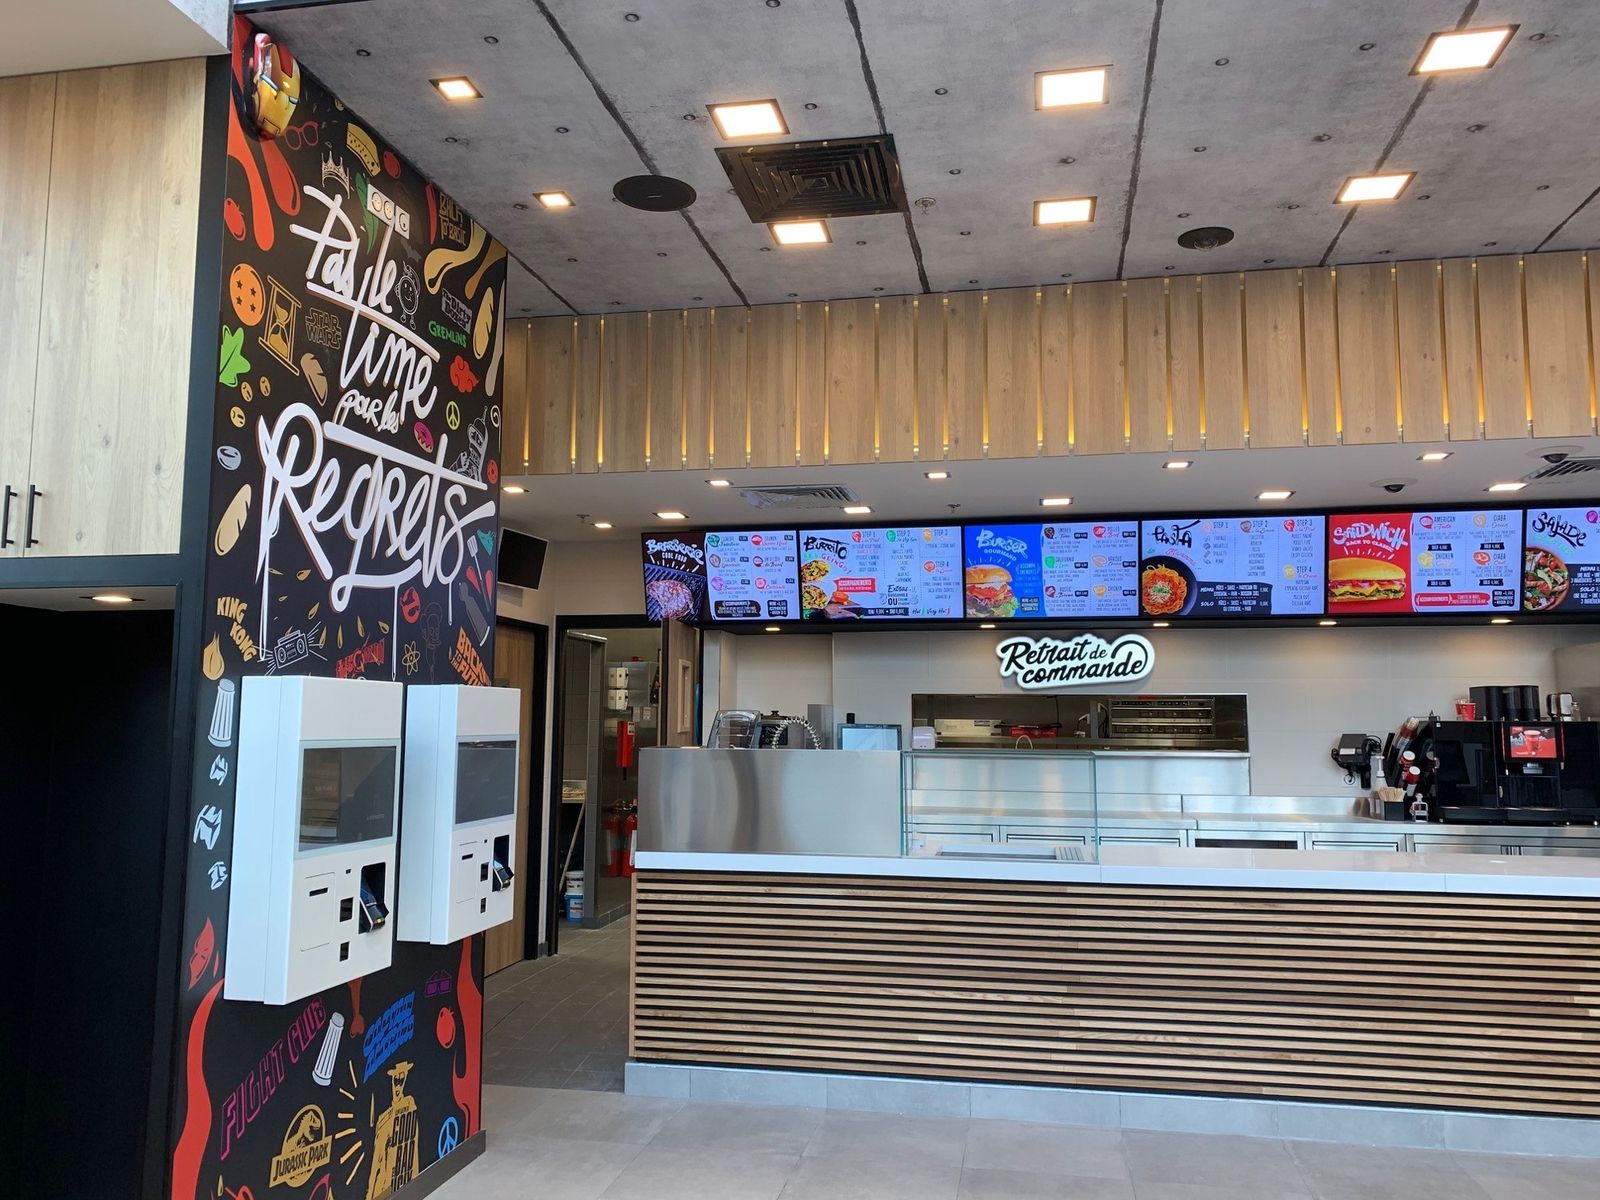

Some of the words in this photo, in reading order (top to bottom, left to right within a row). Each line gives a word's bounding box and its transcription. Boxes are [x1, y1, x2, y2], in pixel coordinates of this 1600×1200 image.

[305, 308, 342, 334] STAR
[428, 320, 467, 348] GREMLINS
[306, 323, 342, 349] WARS
[1264, 520, 1268, 528] 2
[1296, 519, 1308, 527] STEP
[984, 548, 1017, 561] GOURMAND
[217, 597, 248, 623] KING
[888, 598, 898, 606] OU
[229, 621, 257, 662] KONG
[1001, 639, 1091, 672] Retrait
[1089, 644, 1107, 659] de
[1022, 640, 1148, 683] commande
[221, 1038, 285, 1160] FIGHT
[287, 998, 326, 1064] CLUB
[391, 1110, 418, 1148] GOOD
[273, 1147, 309, 1182] JURASSIC
[308, 1142, 329, 1169] PARK
